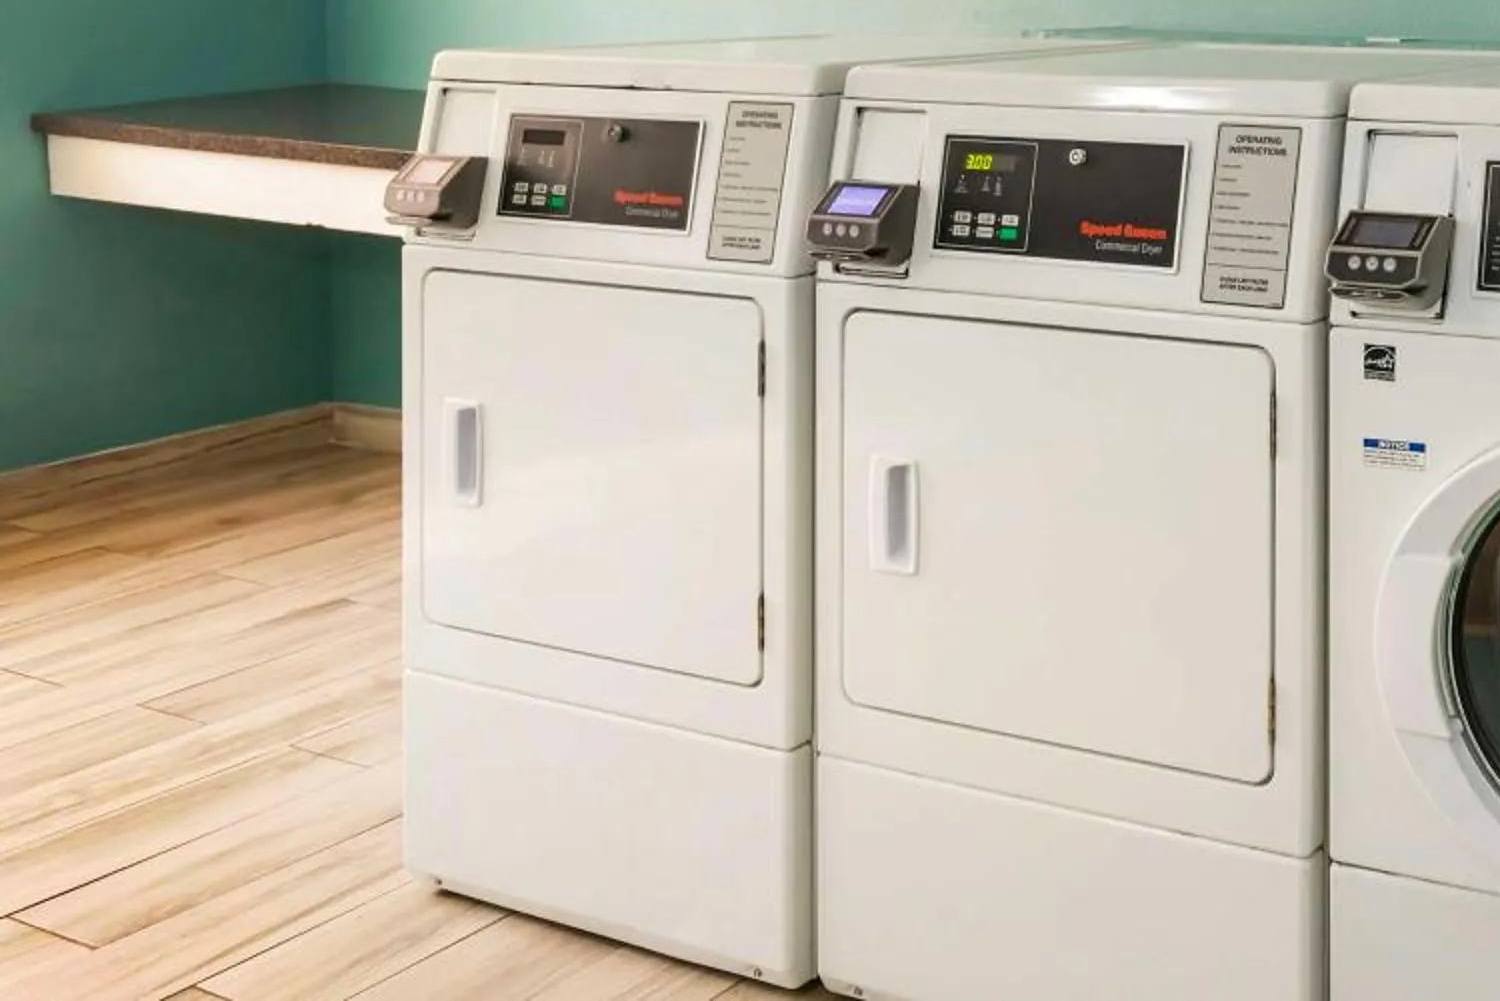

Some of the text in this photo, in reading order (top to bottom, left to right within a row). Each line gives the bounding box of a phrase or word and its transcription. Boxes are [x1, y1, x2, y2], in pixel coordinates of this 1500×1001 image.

[1235, 134, 1282, 145] OPERATING
[1228, 145, 1287, 156] INSTRUCTIONS
[1081, 220, 1168, 240] Speed Queen
[1095, 239, 1163, 255] Commercial Dryer
